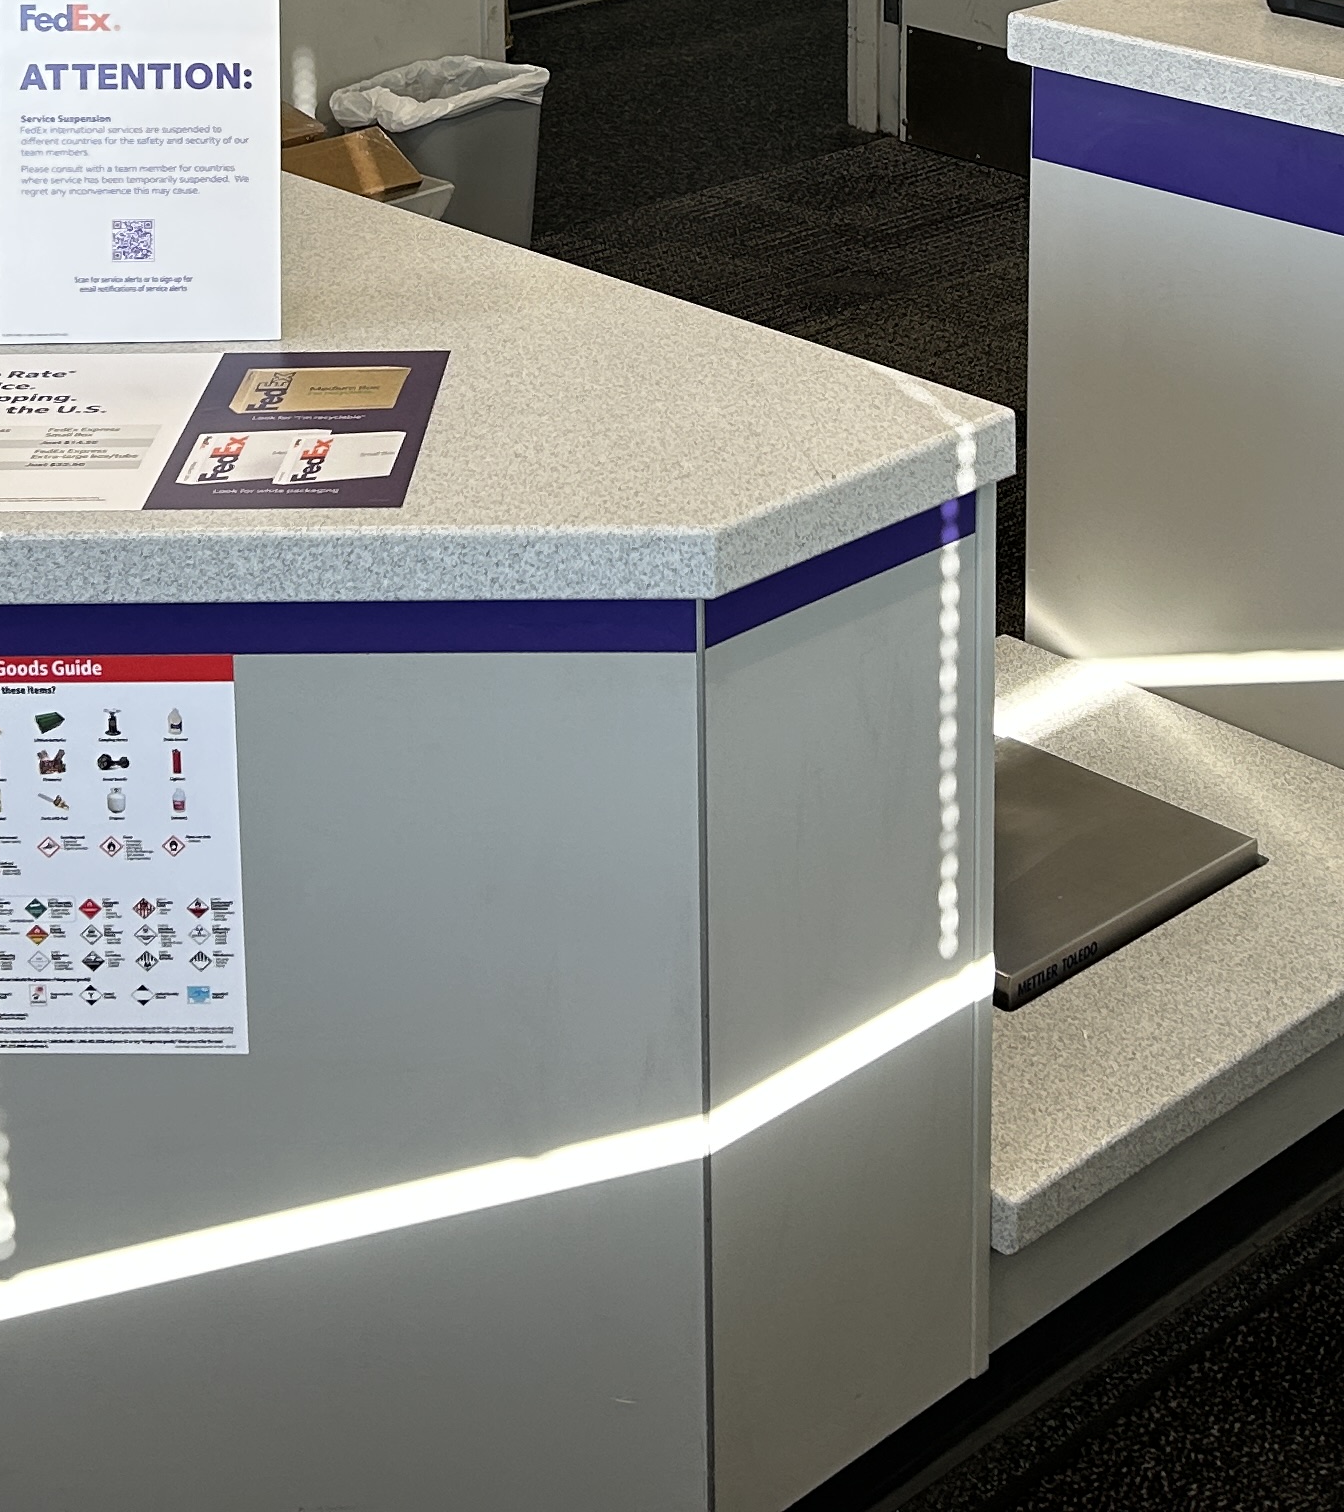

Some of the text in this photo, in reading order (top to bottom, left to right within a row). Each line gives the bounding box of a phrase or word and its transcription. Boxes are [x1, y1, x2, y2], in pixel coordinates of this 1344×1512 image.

[19, 4, 111, 32] FedEx
[20, 63, 253, 91] ATTENTION:
[20, 115, 112, 125] Service Suspension
[20, 126, 48, 134] FedEx
[50, 126, 106, 134] international
[108, 126, 143, 134] services
[162, 126, 210, 135] suspended
[212, 126, 222, 134] to
[21, 137, 59, 146] different
[104, 137, 117, 145] for
[120, 137, 134, 145] the
[137, 137, 164, 146] safety
[185, 137, 220, 146] security
[223, 136, 232, 144] of
[21, 165, 49, 173] Please
[51, 165, 83, 173] consult
[179, 164, 191, 172] for
[194, 164, 235, 172] countries
[21, 176, 48, 184] where
[51, 176, 82, 184] service
[84, 176, 99, 184] has
[102, 176, 124, 184] been
[126, 176, 177, 185] temporarily
[21, 188, 48, 197] regret
[51, 189, 66, 197] any
[152, 188, 170, 196] may
[244, 372, 297, 412] FedEx
[5, 406, 50, 414] the
[56, 405, 107, 414] U.S.
[198, 435, 250, 482] FedEx
[290, 438, 334, 482] FedEx
[52, 660, 102, 676] Guide
[1018, 942, 1098, 997] METTLER TOLEDO
